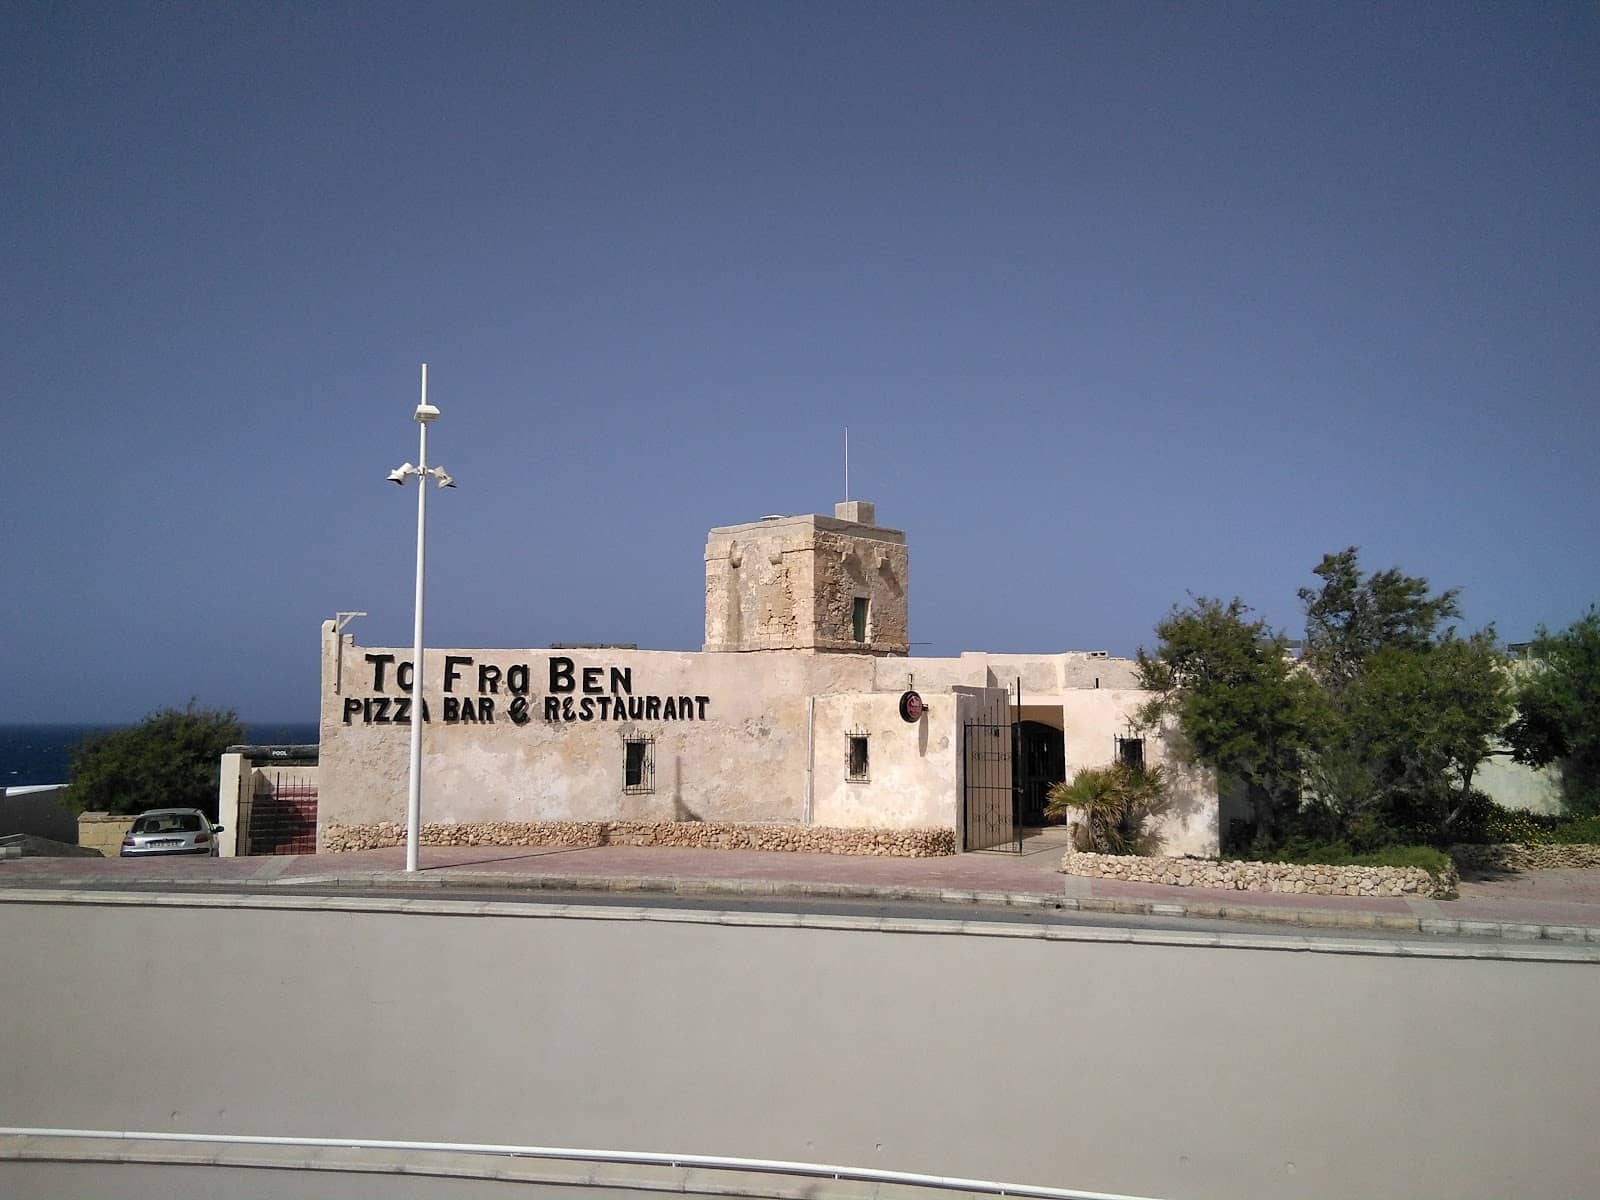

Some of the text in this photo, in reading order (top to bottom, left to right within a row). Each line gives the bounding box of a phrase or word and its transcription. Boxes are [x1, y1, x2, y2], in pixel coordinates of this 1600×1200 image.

[549, 656, 631, 693] BEN
[443, 697, 494, 721] BAR
[545, 696, 709, 720] RESTAURANT
